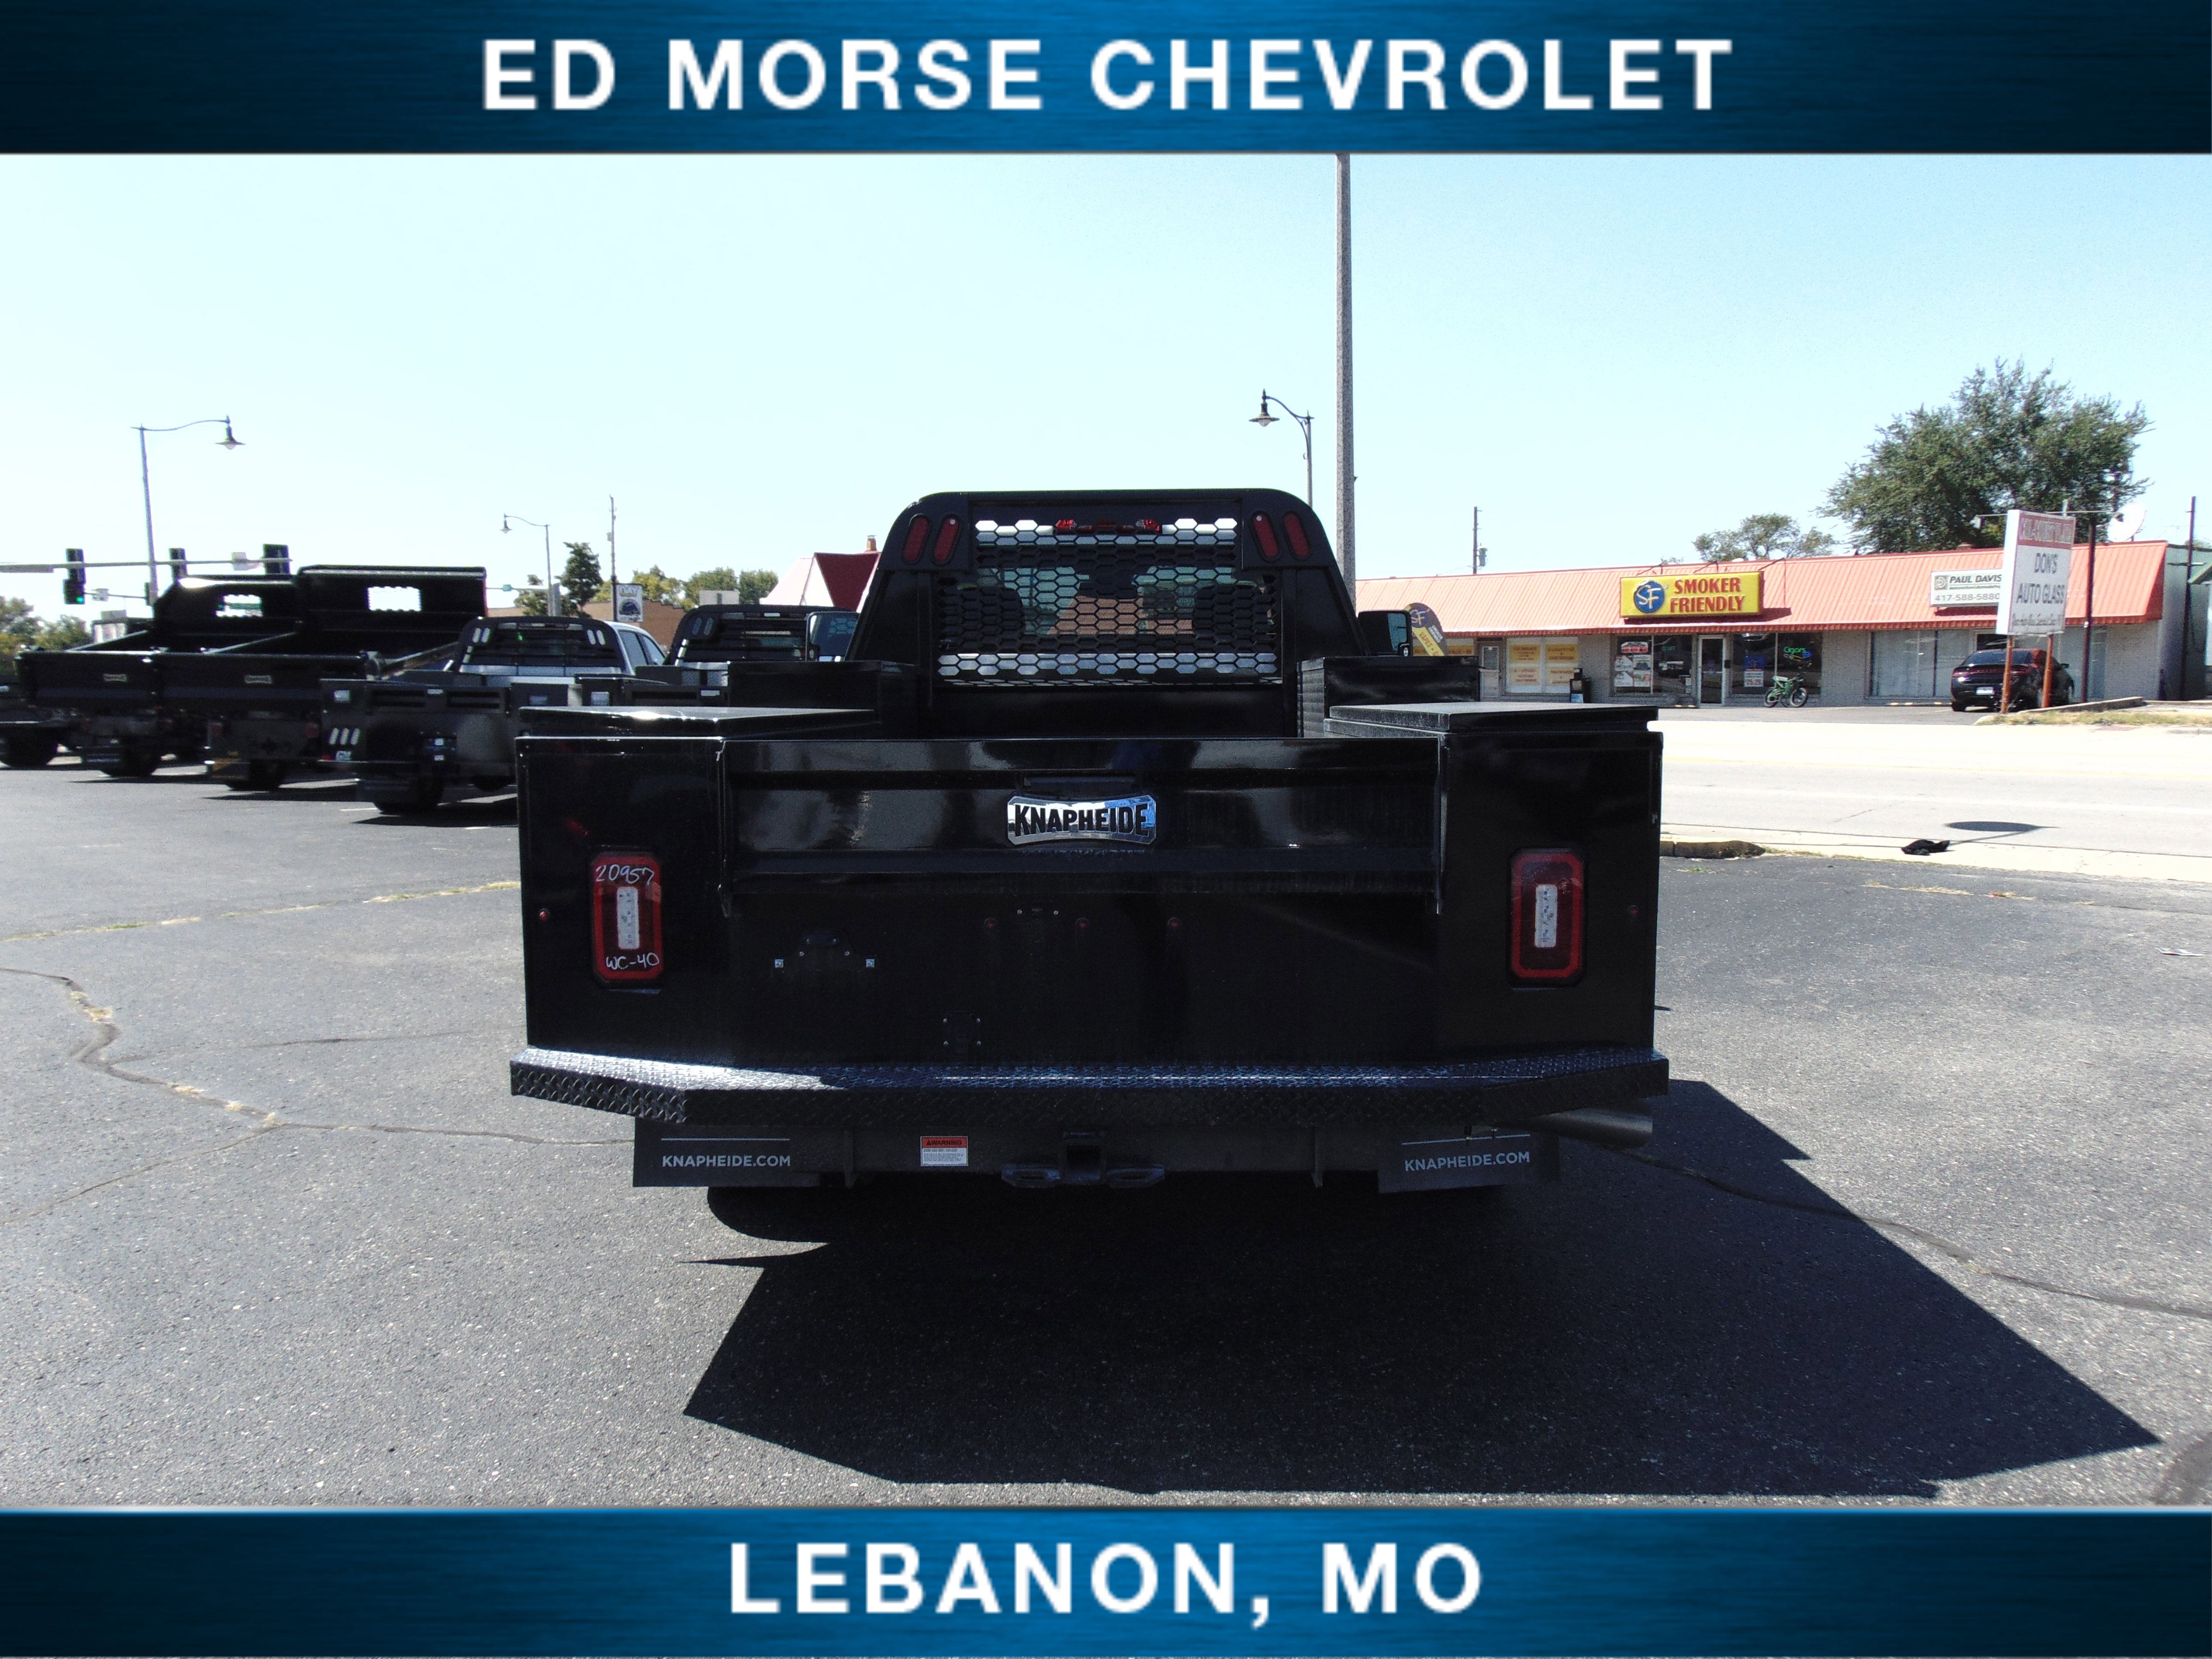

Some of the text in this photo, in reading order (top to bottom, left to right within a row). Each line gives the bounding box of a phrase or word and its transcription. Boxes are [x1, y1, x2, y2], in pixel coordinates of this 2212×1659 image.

[1674, 577, 1741, 594] SMOKER
[1949, 574, 2002, 583] PAUL DAVIS
[2016, 583, 2065, 604] AUTO GLASS
[1669, 596, 1745, 613] FRIENDLY
[1015, 803, 1149, 837] KNAPHEIDE
[596, 864, 654, 885] 20957
[606, 952, 659, 969] WC-40
[662, 1155, 791, 1167] KNAPHEIDE.COM
[1404, 1151, 1530, 1172] KNAPHEIDE.COM
